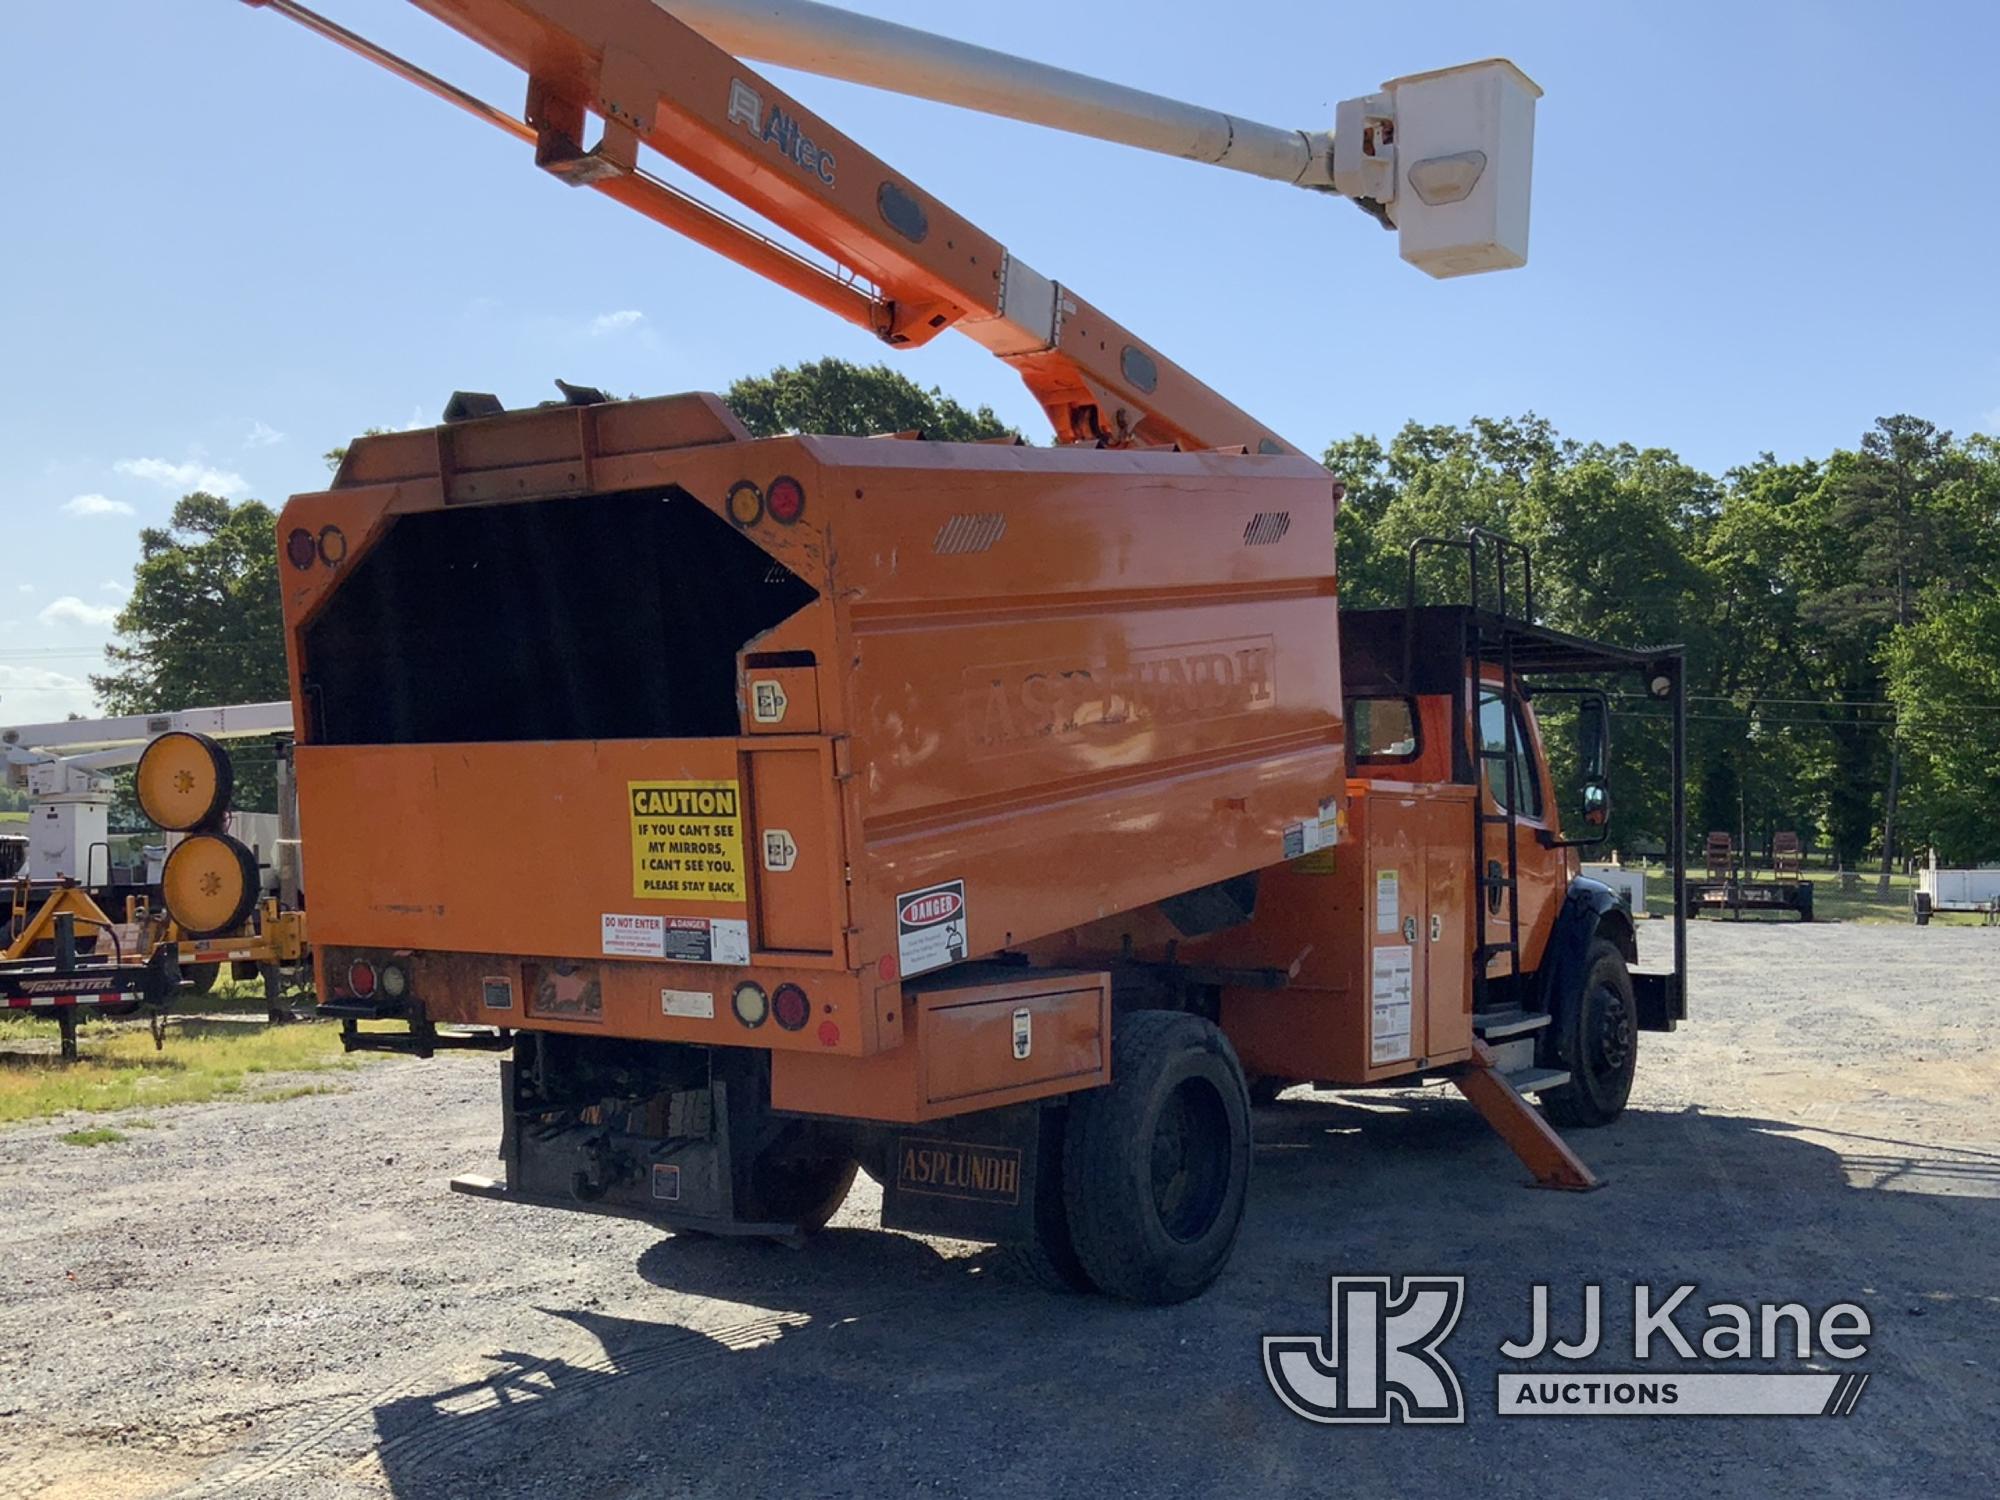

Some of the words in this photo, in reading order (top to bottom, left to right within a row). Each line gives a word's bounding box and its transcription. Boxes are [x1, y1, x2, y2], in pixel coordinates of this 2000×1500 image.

[763, 104, 836, 184] Altec
[635, 791, 734, 814] CAUTION
[638, 824, 648, 836] IF
[651, 824, 675, 836] YOU
[678, 825, 710, 837] CAN'T
[714, 825, 734, 837] SEE
[648, 842, 665, 853] MY
[669, 842, 726, 857] MIRRORS,
[642, 859, 646, 870] I
[649, 859, 681, 871] CAN'T
[685, 860, 704, 872] SEE
[707, 860, 735, 873] YOU.
[643, 880, 679, 891] PLEASE
[682, 881, 705, 892] STAY
[708, 882, 735, 893] BACK
[910, 895, 954, 922] DANGER
[605, 916, 616, 927] DO
[617, 917, 633, 928] NOT
[635, 918, 661, 930] ENTER
[677, 918, 707, 929] DANGER
[902, 1147, 1018, 1193] ASPLUNDH
